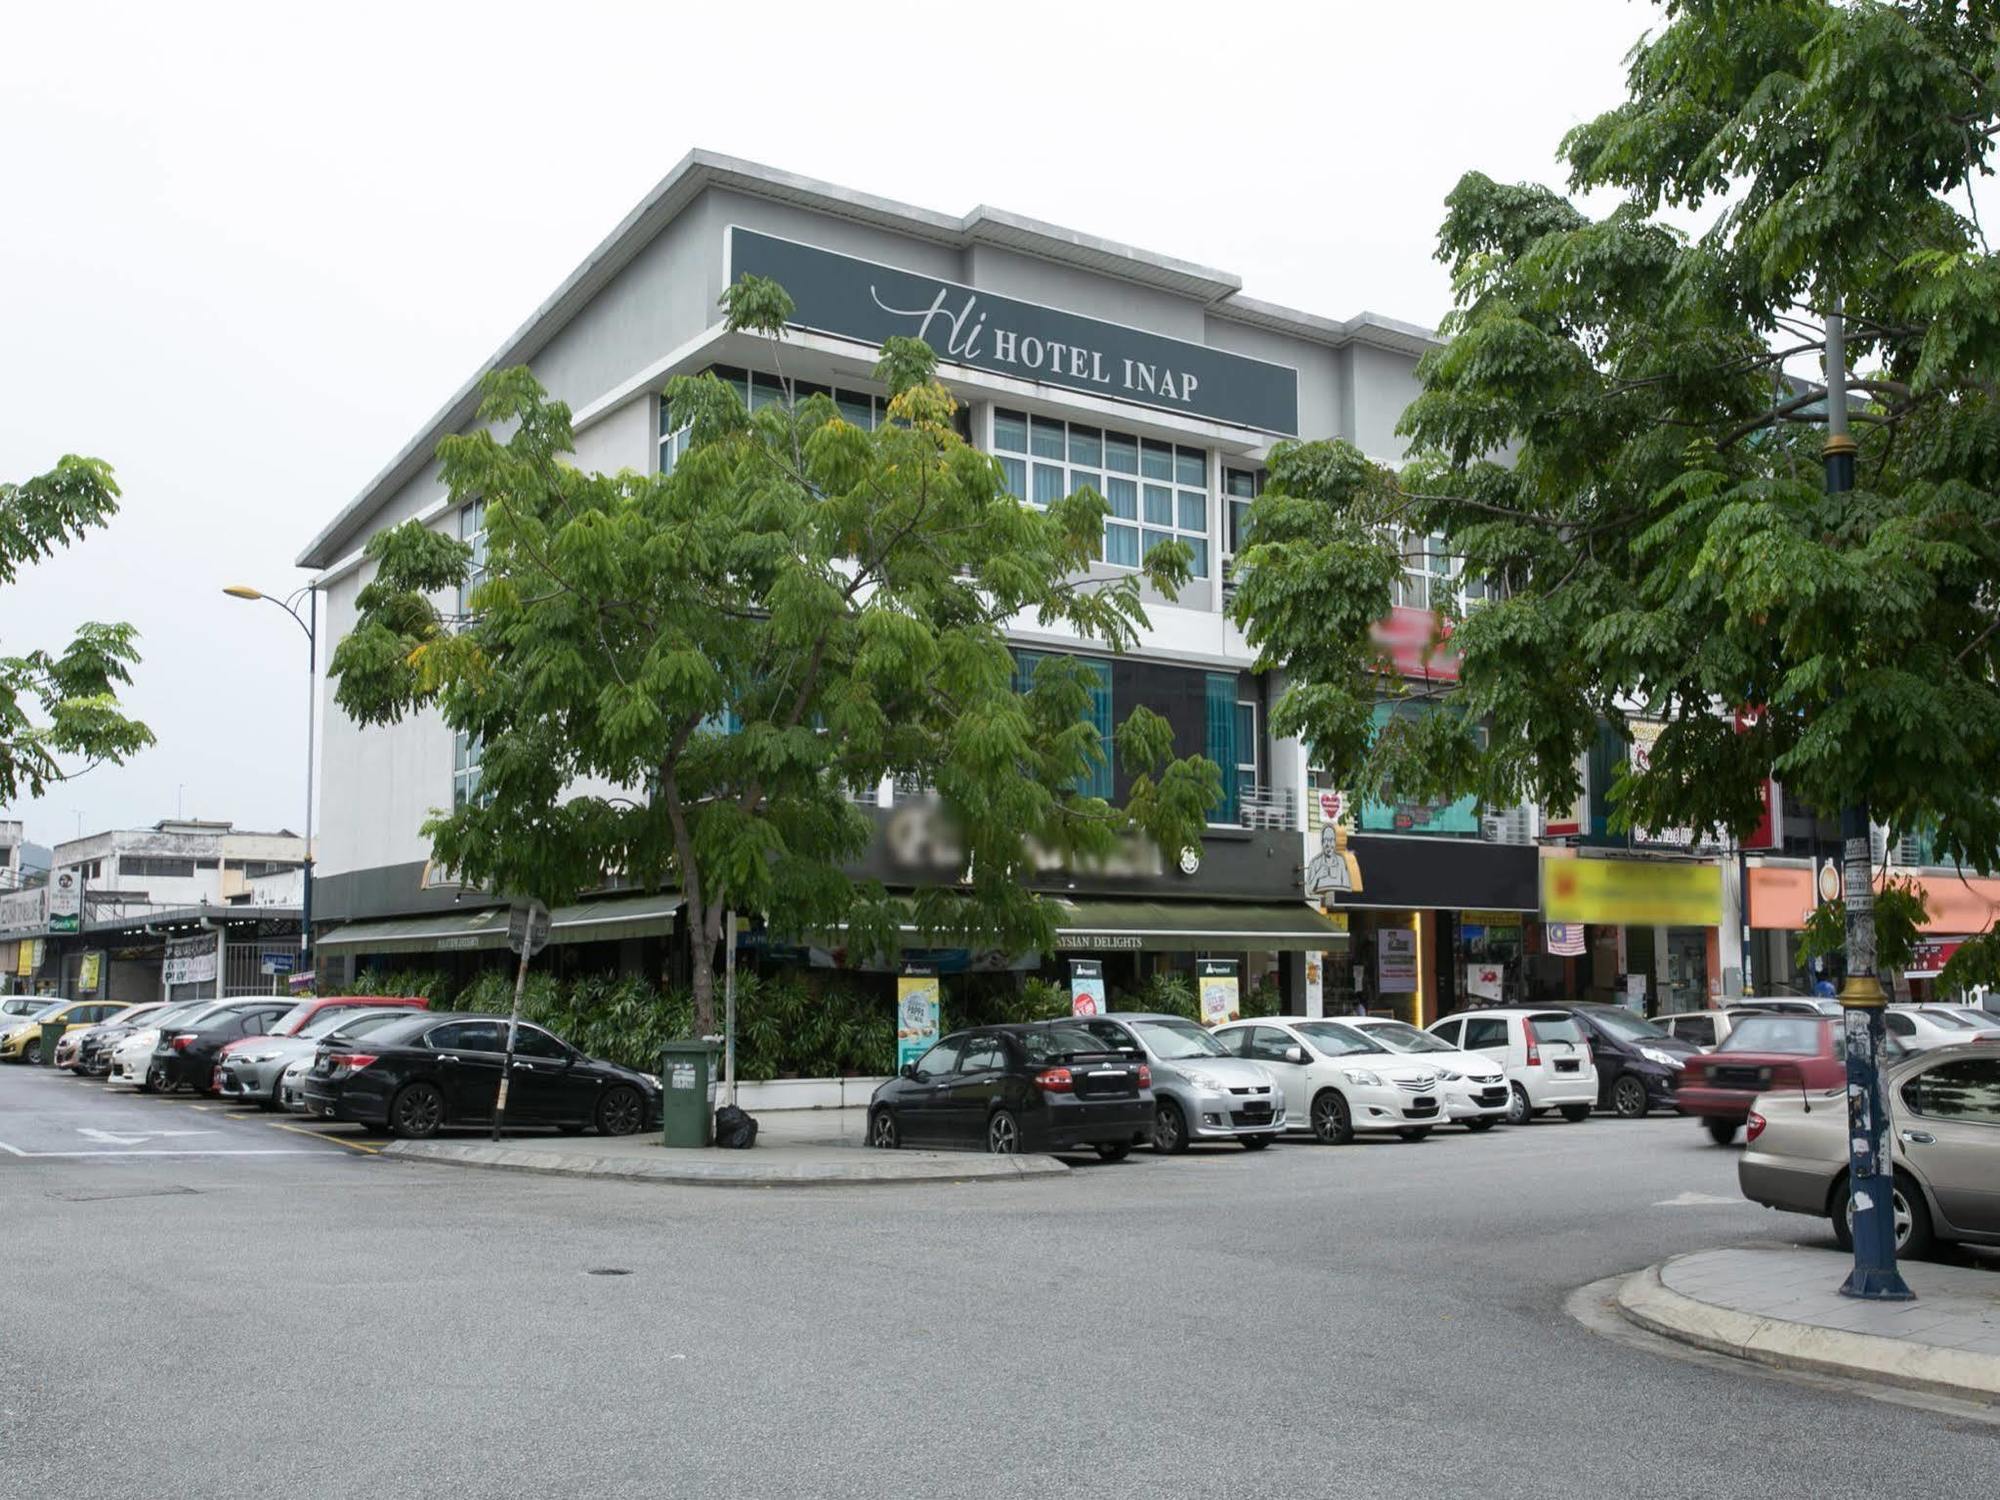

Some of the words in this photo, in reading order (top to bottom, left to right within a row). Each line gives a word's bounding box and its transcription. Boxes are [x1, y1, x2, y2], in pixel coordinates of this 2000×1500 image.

[870, 285, 987, 359] Hi
[993, 328, 1111, 384] HOTEL
[1122, 358, 1199, 402] INAP
[1093, 936, 1143, 948] DELIGHTS
